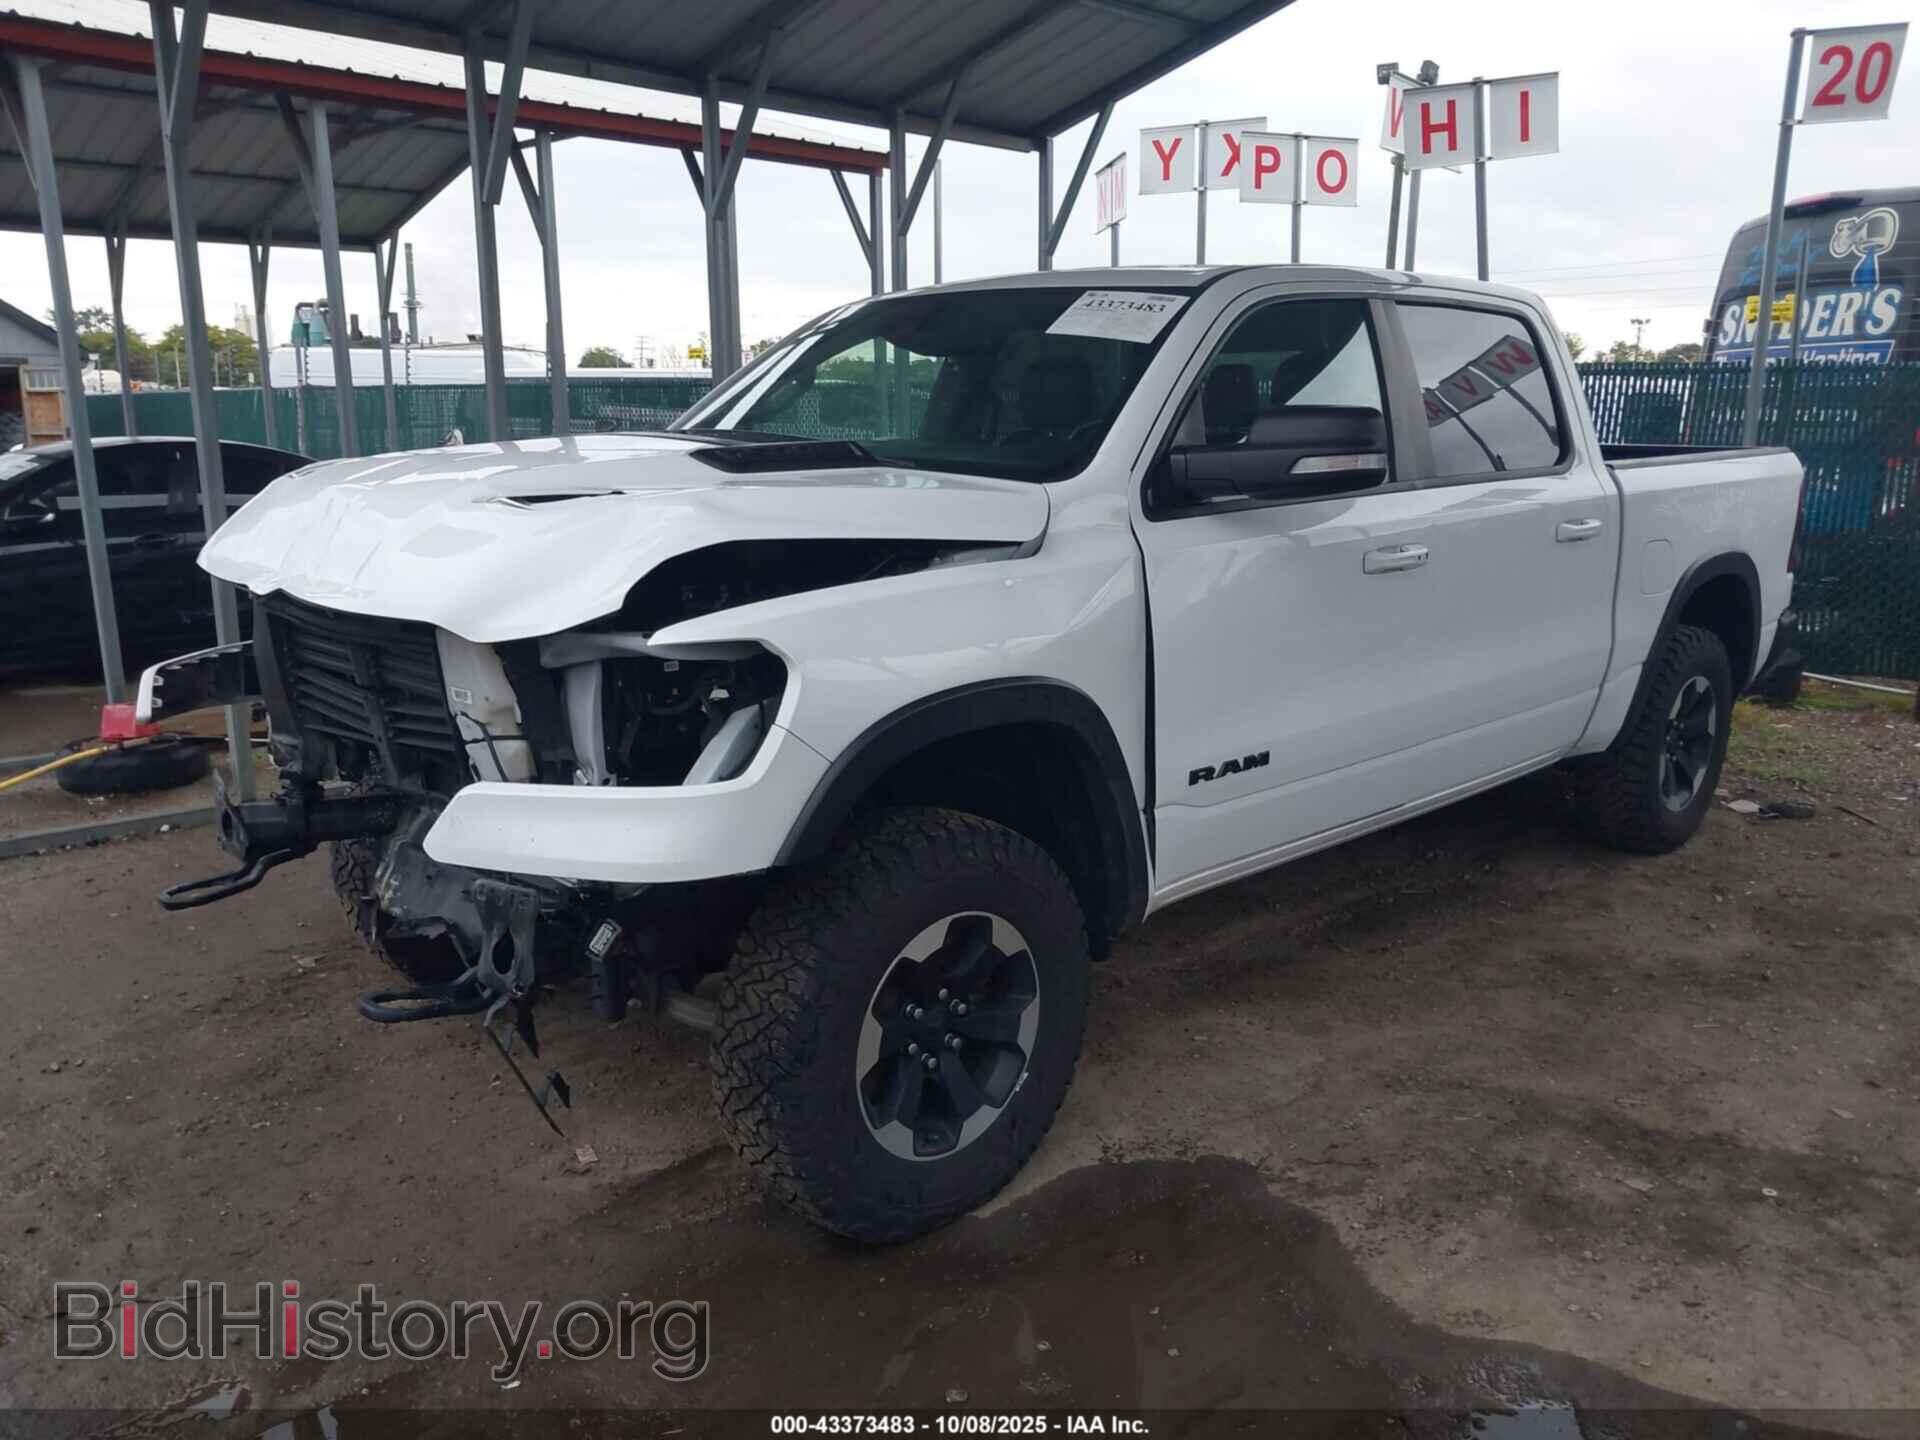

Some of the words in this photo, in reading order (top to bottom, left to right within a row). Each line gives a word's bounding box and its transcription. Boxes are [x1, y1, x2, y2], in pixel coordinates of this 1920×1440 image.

[1811, 41, 1894, 107] 20
[1419, 99, 1458, 154] H
[1520, 90, 1530, 143] I
[1152, 137, 1182, 182] Y
[1253, 144, 1282, 191] P
[1316, 149, 1349, 195] O
[1718, 288, 1902, 347] SNDER'S
[1188, 750, 1270, 787] RAM
